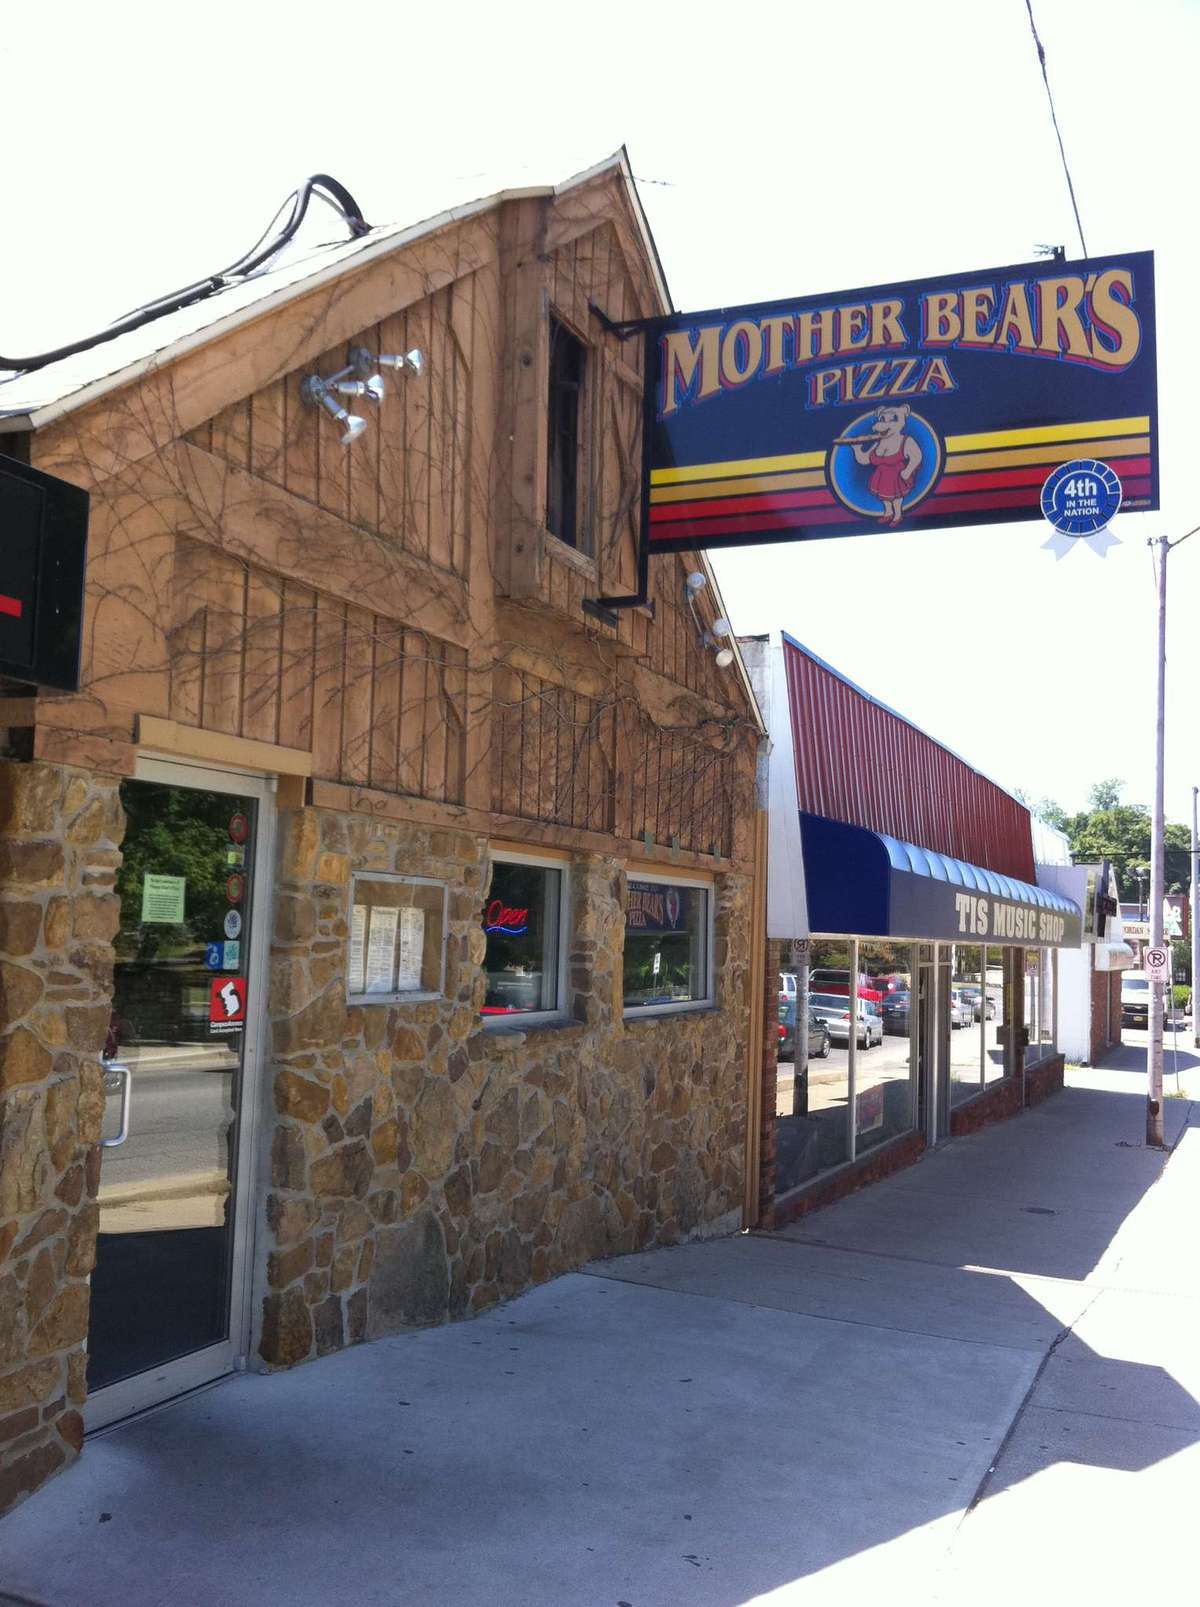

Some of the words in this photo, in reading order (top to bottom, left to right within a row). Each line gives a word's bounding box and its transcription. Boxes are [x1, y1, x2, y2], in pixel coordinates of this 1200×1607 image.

[660, 299, 909, 414] MOTHER
[921, 268, 1142, 370] BEAR'S
[810, 355, 957, 408] PIZZA
[1064, 478, 1098, 498] 4th
[1064, 507, 1100, 517] NATION
[1066, 500, 1076, 508] IN
[1079, 498, 1097, 507] THE
[487, 899, 529, 927] Open
[955, 893, 989, 936] TIS
[993, 902, 1037, 940] MUSIC
[1039, 912, 1065, 943] SHOP
